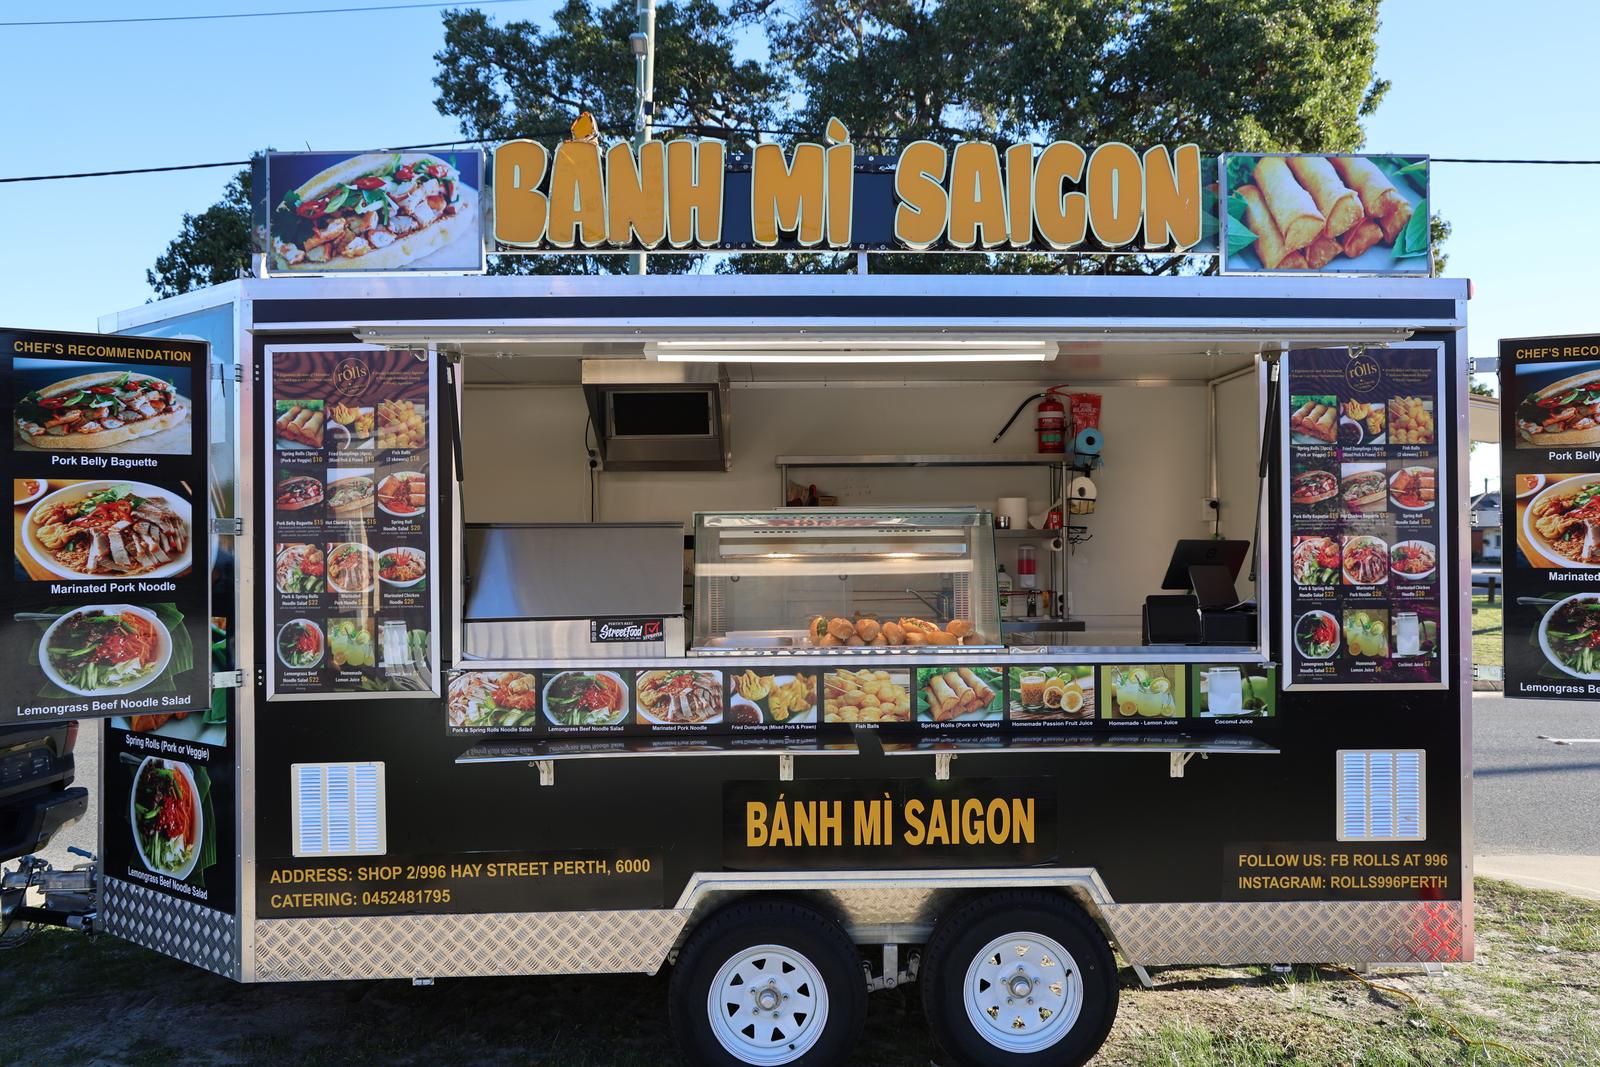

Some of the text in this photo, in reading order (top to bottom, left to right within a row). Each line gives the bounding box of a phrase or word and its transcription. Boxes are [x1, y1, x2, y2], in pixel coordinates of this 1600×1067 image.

[893, 139, 1202, 251] SAIGON
[13, 340, 192, 362] CHEF'S RECOMMENDATION
[1516, 345, 1600, 359] CHEF'S RECO
[52, 455, 158, 469] Pork Belly Baguette
[1548, 451, 1573, 461] Pork
[51, 581, 177, 595] Marinated Pork Noodle
[1519, 682, 1585, 695] Lemongrass
[17, 695, 192, 716] Lemongrass Beef Noodle Salad
[921, 722, 940, 730] Spring
[125, 733, 210, 761] Spring Rolls (Pork or Veggie)
[746, 791, 1036, 847] BÁNH MÌ SAIGON
[1238, 853, 1449, 868] FOLLOW US: FB ROLLS AT 996
[270, 858, 651, 885] ADDRESS: SHOP 2/996 HAY STREET PERTH, 6000
[127, 865, 208, 900] Lemongrass Beef Noodle Salad
[1238, 875, 1449, 889] INSTAGRAM: ROLLS996PERTH
[270, 889, 451, 910] CATERING: 0452481795
